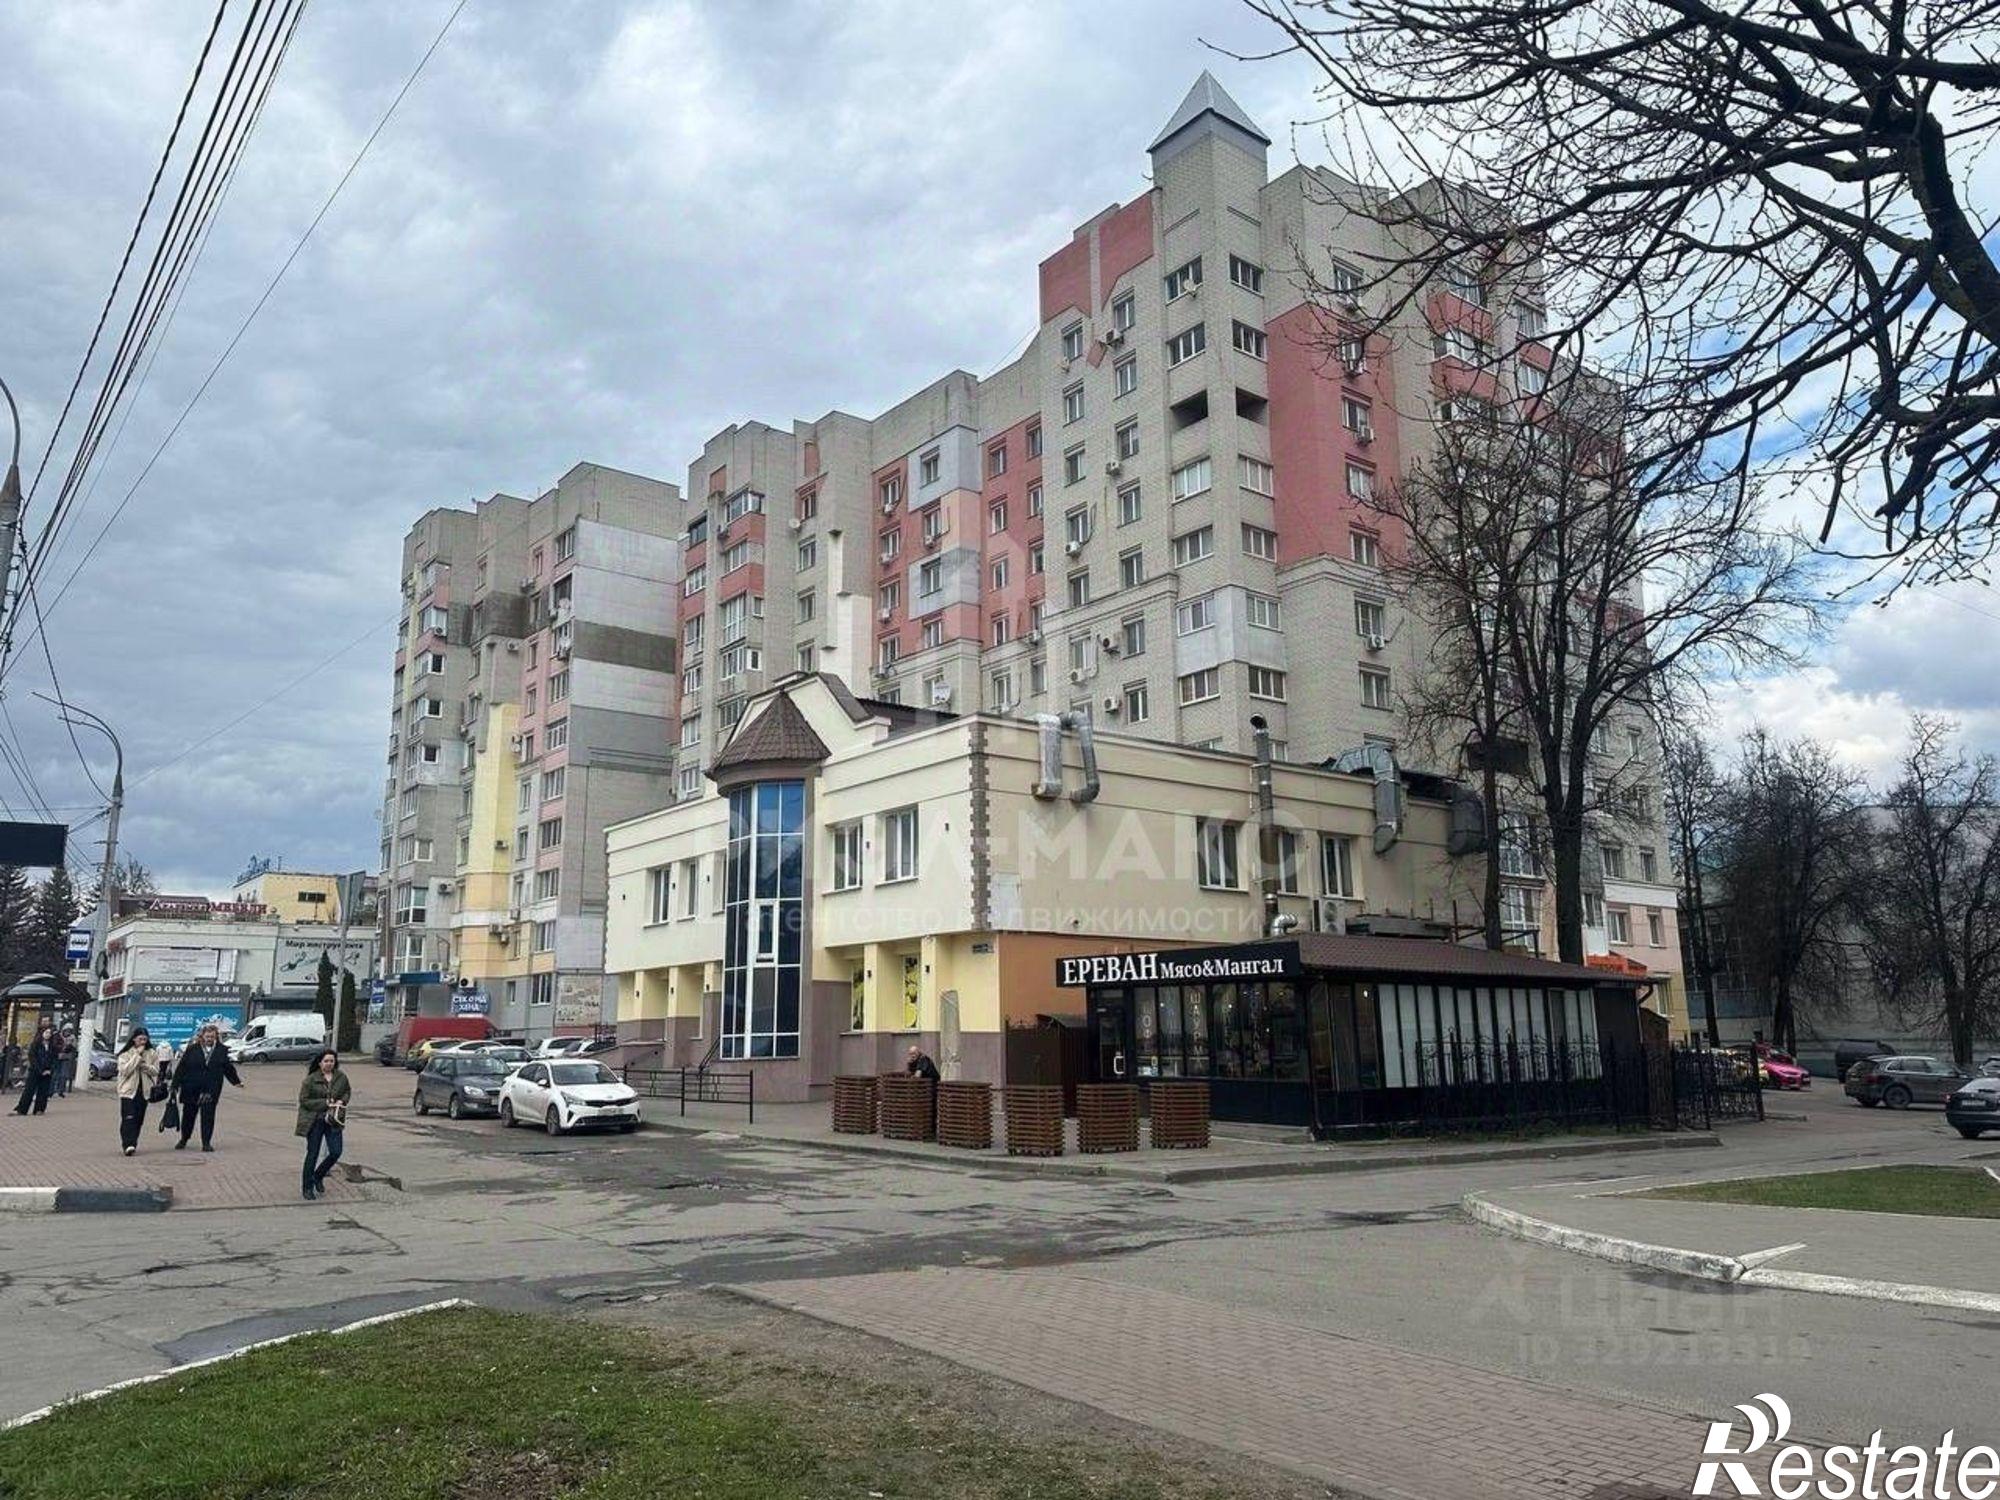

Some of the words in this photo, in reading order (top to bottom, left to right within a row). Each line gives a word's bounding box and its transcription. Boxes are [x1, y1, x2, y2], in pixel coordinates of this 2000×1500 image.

[1063, 953, 1158, 984] ЕРЕВАН
[1160, 958, 1284, 979] Мясо&Мангал
[144, 985, 241, 993] ЗООМАГАЗИН
